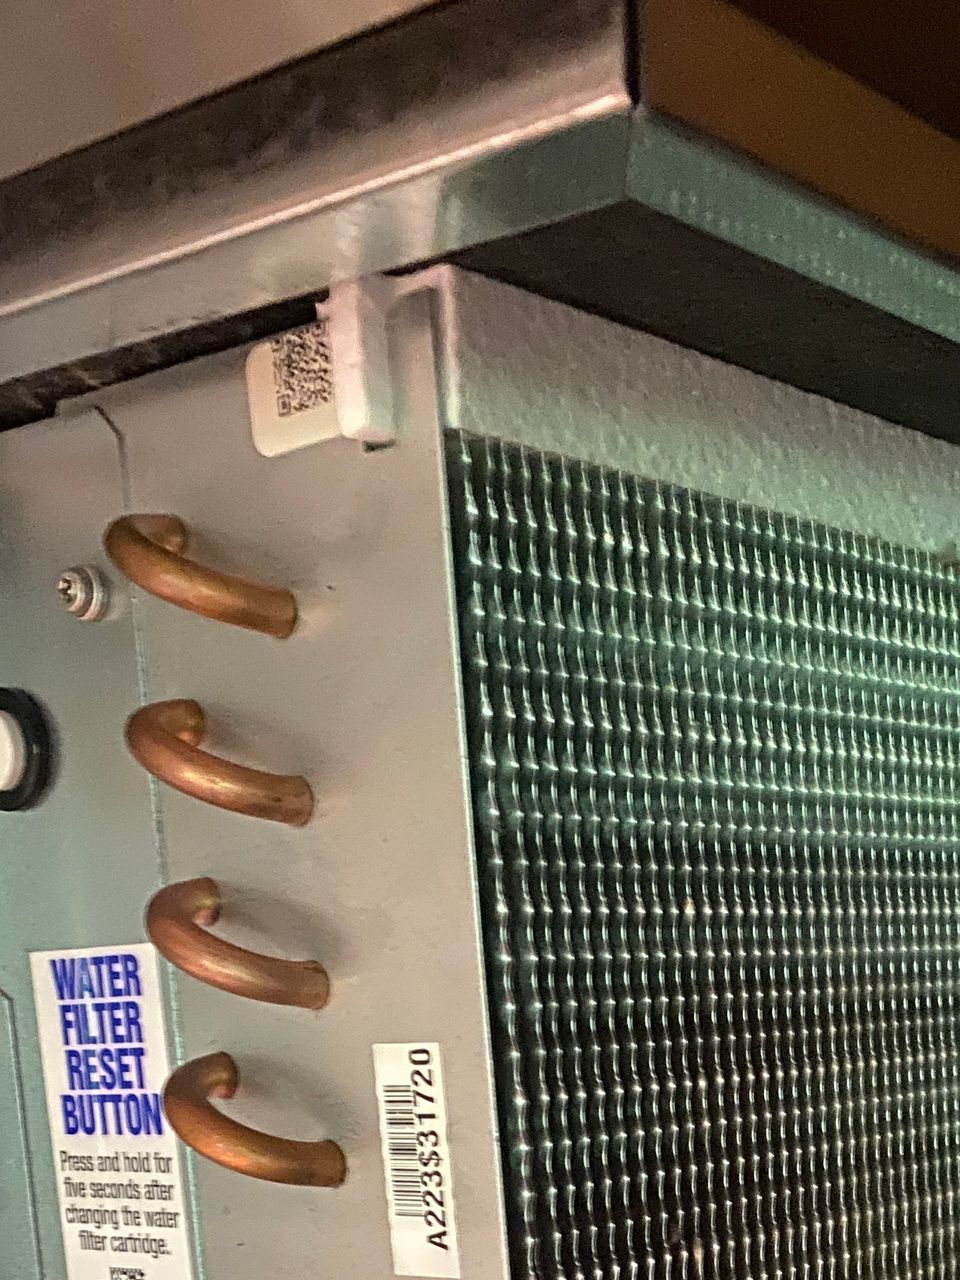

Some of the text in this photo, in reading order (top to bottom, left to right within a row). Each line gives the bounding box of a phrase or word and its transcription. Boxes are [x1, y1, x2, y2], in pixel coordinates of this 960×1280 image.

[50, 954, 143, 1000] WATER
[58, 1001, 144, 1045] FILTER
[65, 1047, 145, 1091] RESET
[60, 1093, 165, 1136] BUTTON
[59, 1150, 173, 1174] Press and hold for
[63, 1176, 174, 1201] five seconds after
[65, 1203, 181, 1230] changing the water
[78, 1229, 173, 1259] filter cartridge.
